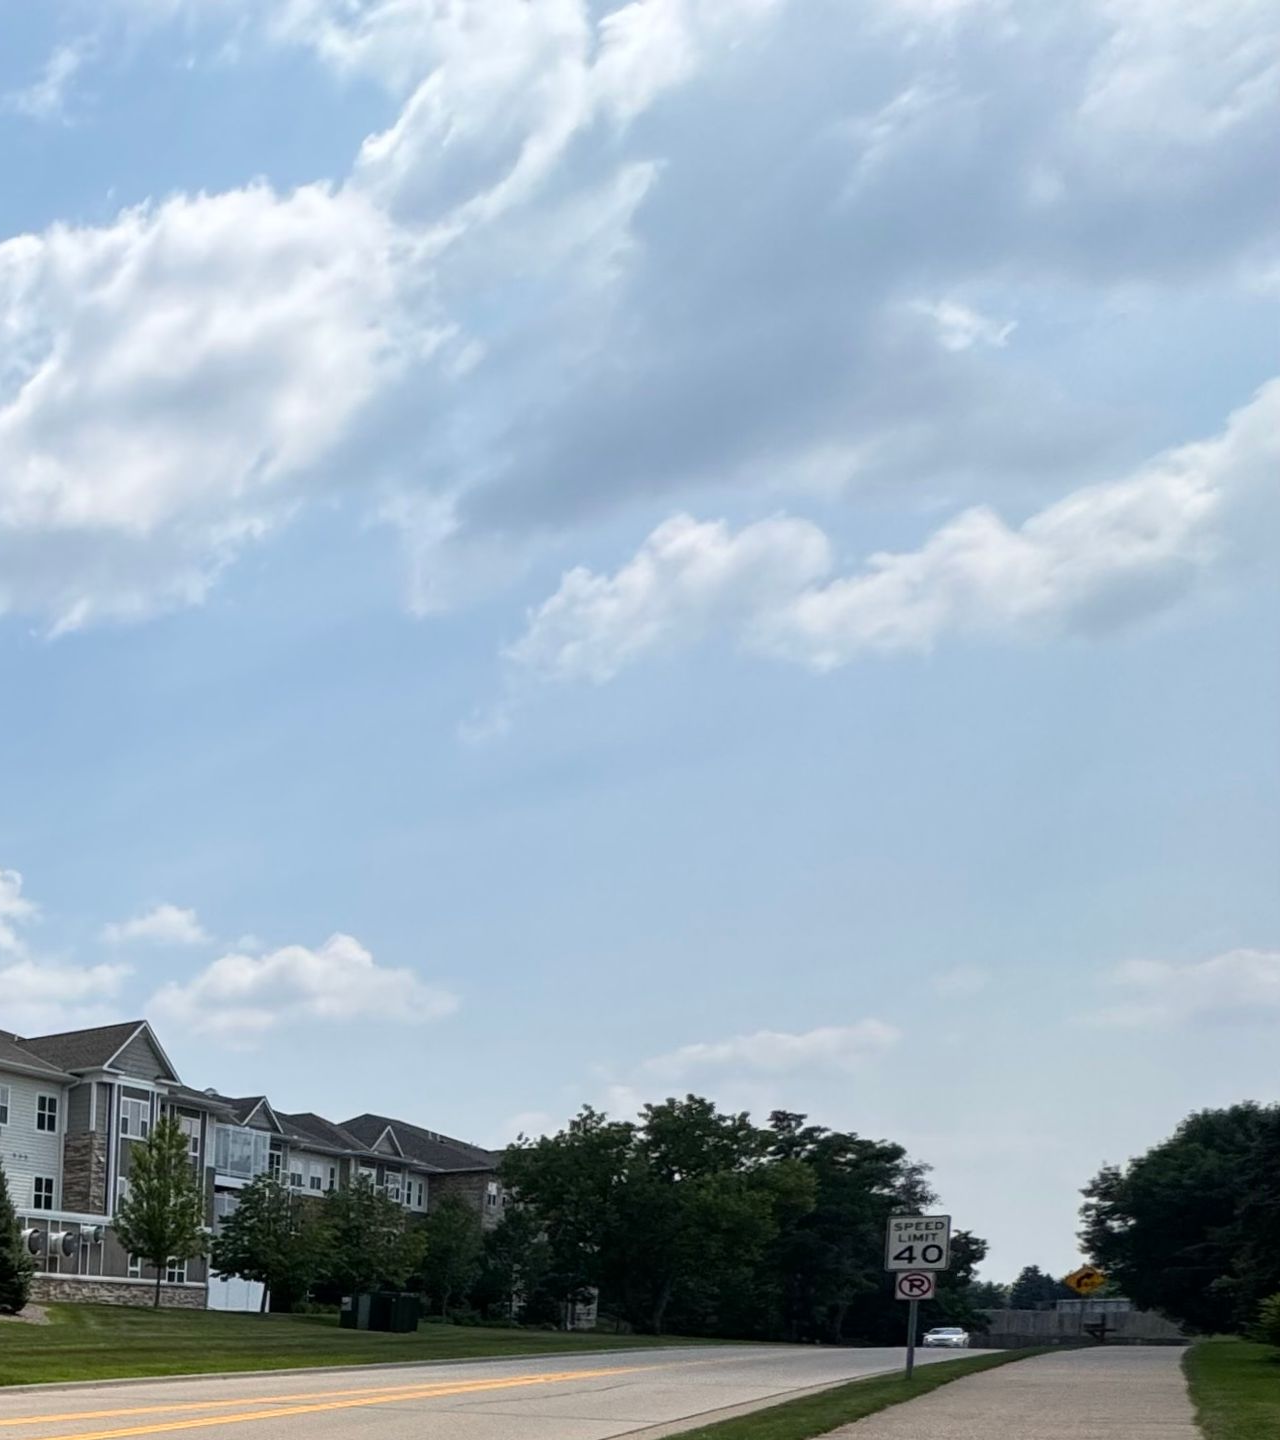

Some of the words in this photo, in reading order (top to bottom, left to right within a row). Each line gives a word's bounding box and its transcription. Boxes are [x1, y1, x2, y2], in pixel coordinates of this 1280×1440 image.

[893, 1221, 945, 1231] SPEED
[898, 1232, 939, 1243] LIMIT
[893, 1244, 943, 1264] 40
